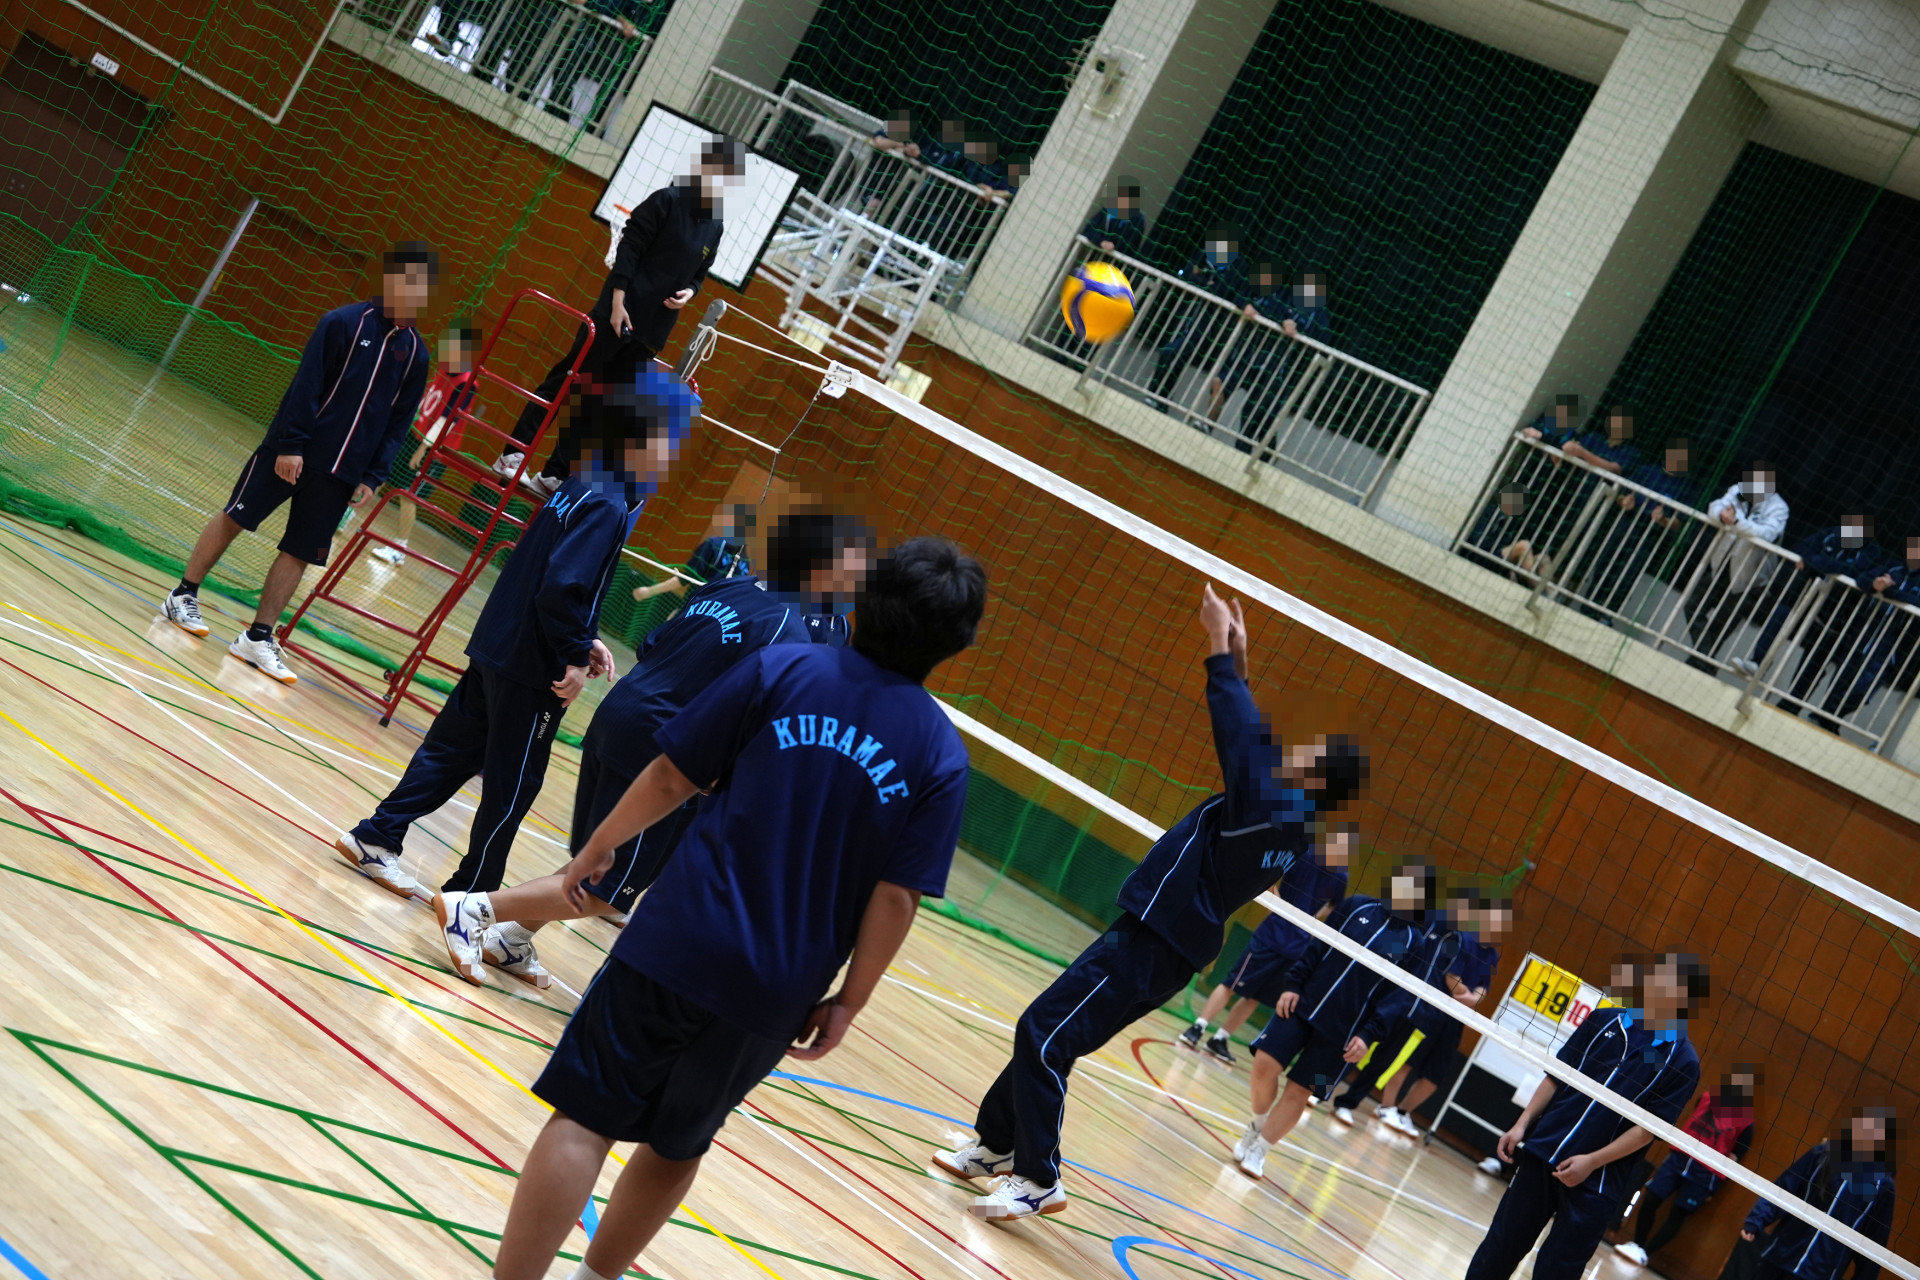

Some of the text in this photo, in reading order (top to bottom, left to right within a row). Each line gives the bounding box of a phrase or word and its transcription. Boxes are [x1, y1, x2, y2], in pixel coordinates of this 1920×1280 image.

[685, 600, 742, 644] KURAMAE
[772, 714, 909, 804] KURAMAE
[1535, 981, 1591, 1028] 19 10
